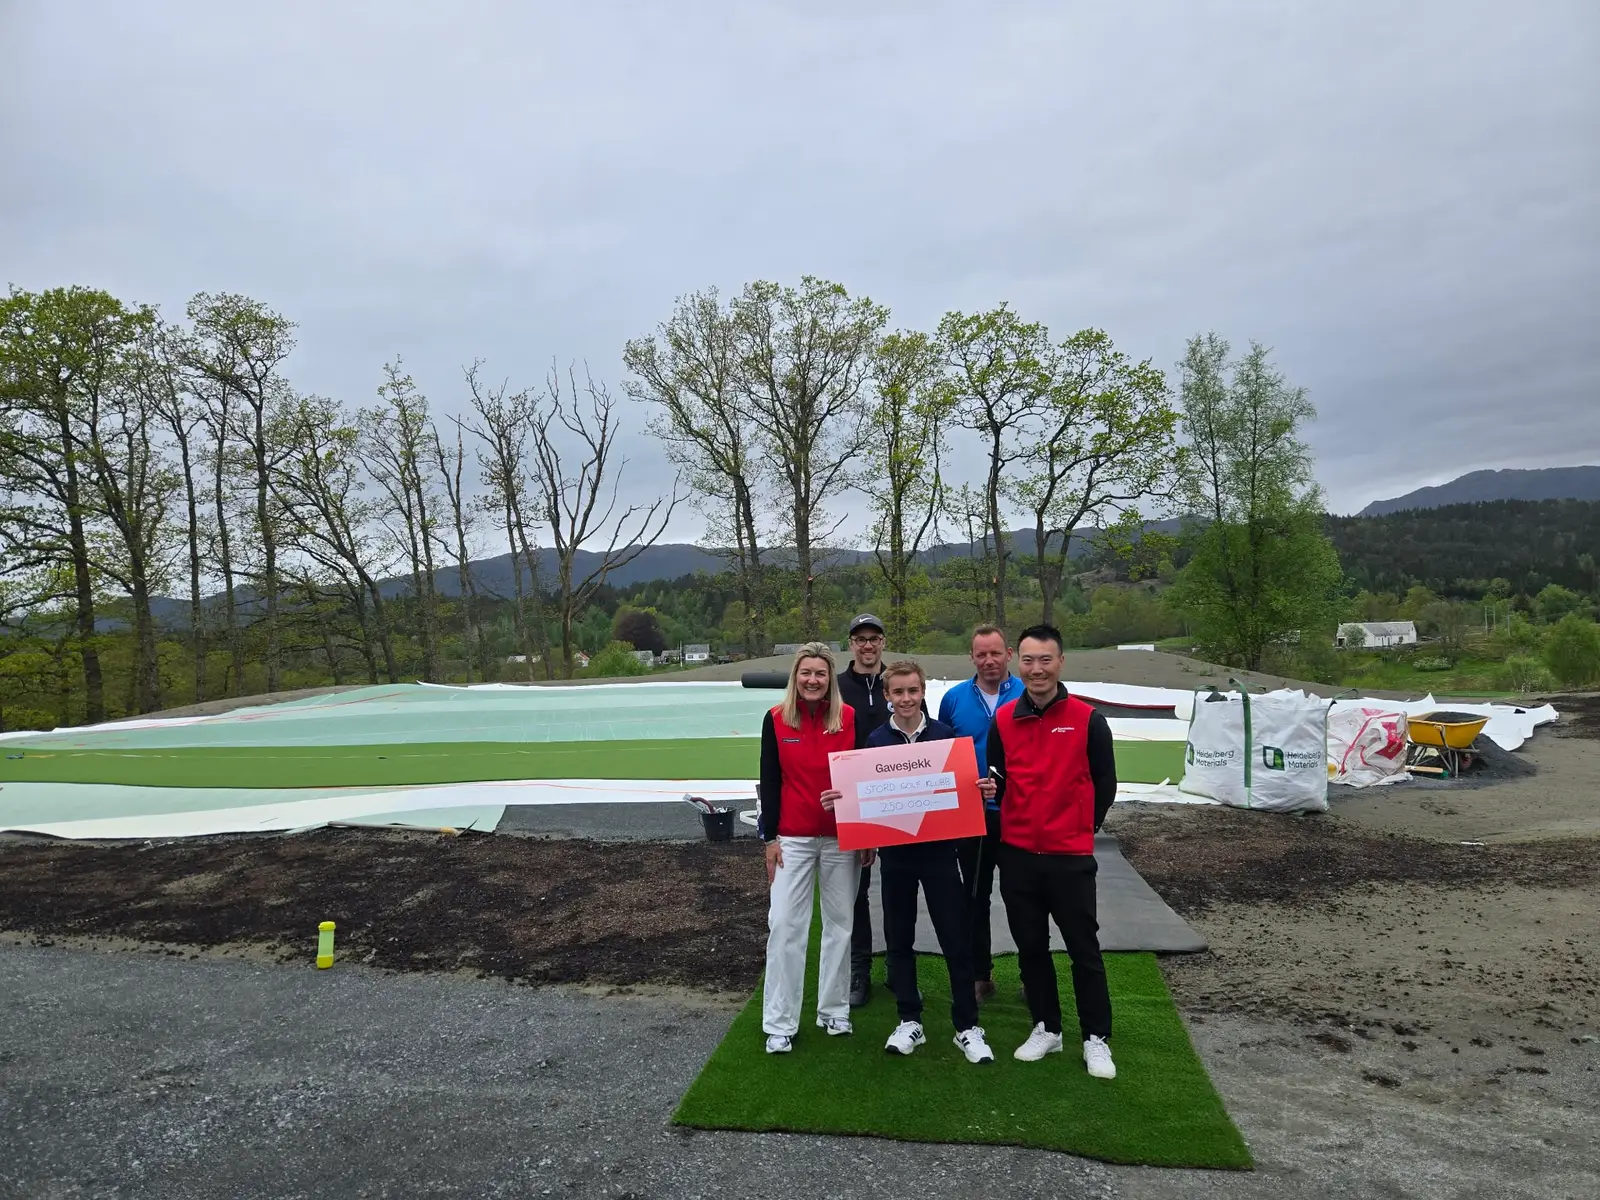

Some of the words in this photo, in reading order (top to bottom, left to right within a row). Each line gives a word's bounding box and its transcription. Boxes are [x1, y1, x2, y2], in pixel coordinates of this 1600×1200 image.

[1196, 749, 1234, 759] Heidelberg
[875, 759, 932, 774] Gavesjekk
[864, 782, 896, 795] STORD
[880, 801, 904, 813] 250
